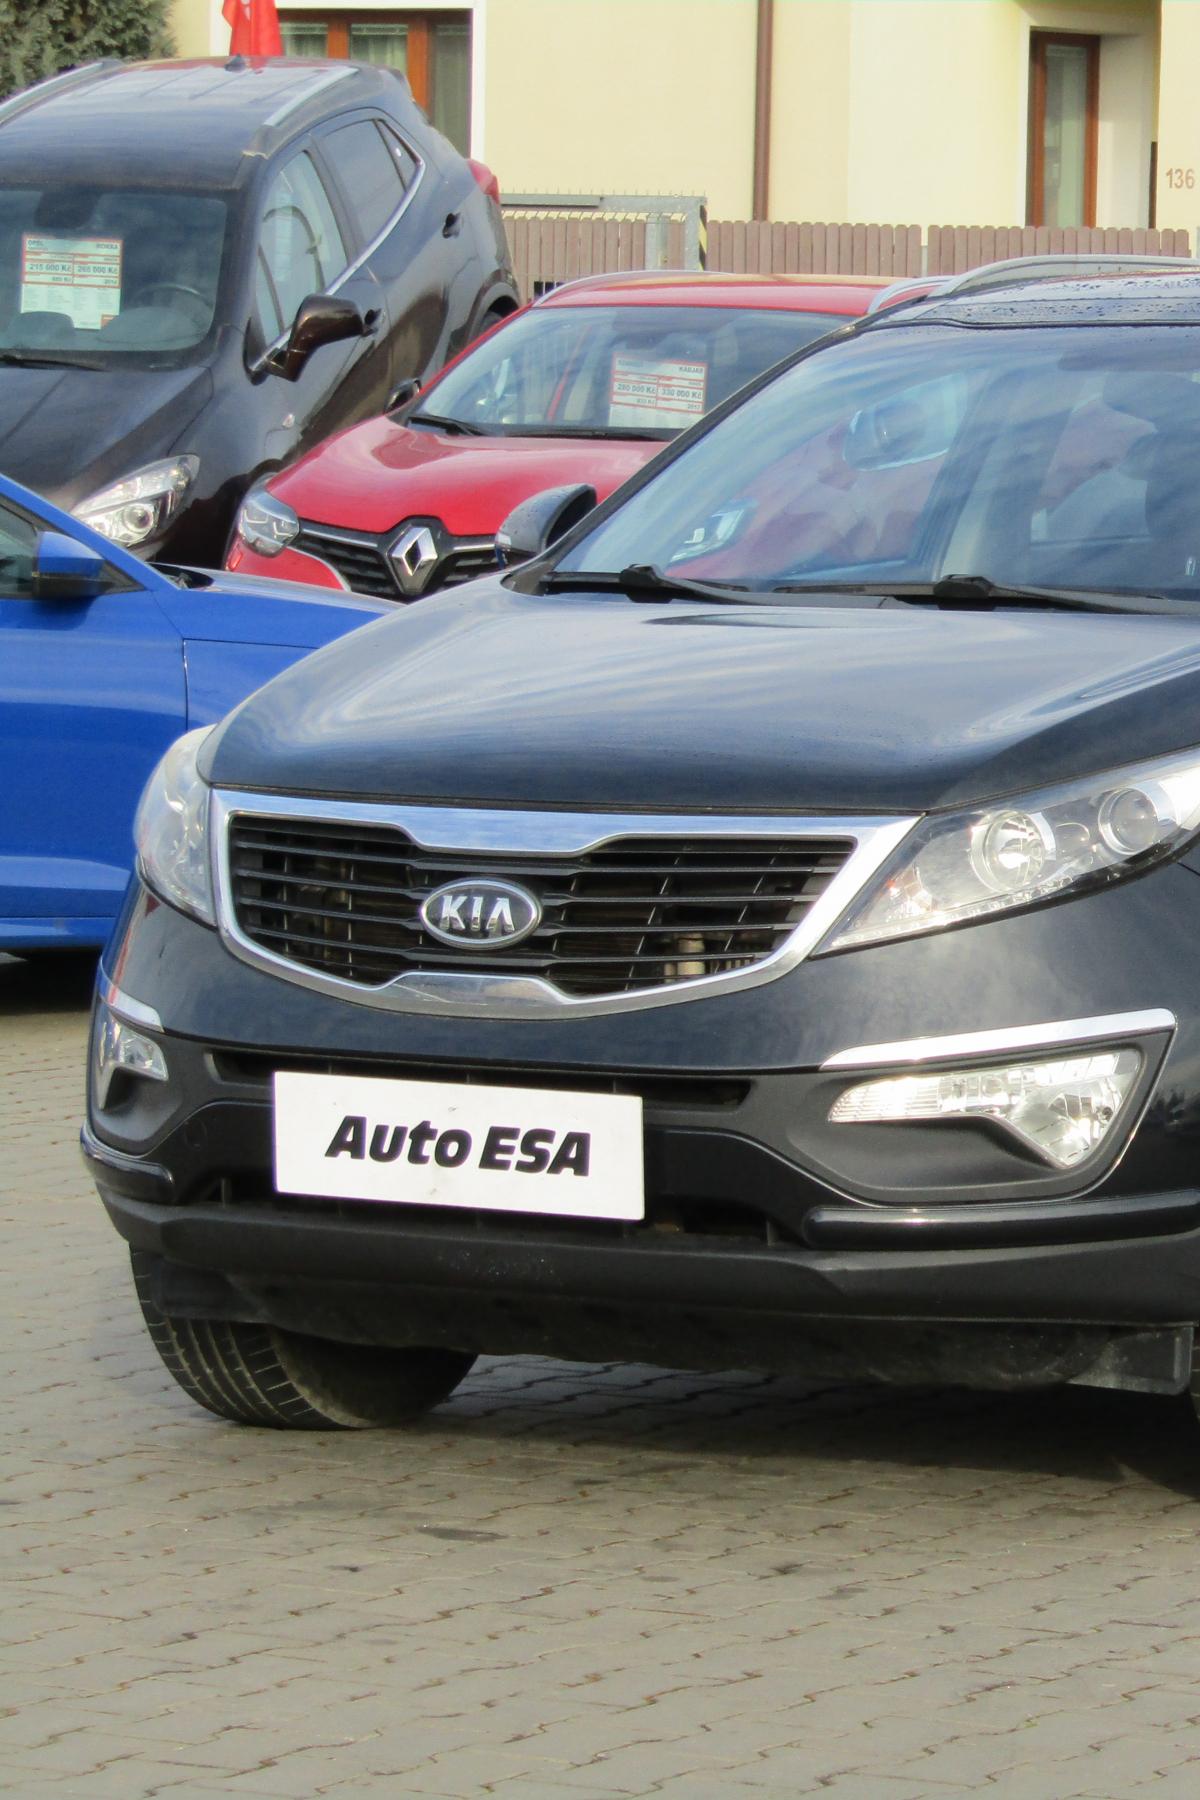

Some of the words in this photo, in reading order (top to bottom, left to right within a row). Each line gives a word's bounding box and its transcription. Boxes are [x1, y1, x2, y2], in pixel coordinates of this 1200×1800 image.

[1165, 167, 1195, 190] 136
[438, 894, 516, 932] KIA
[325, 1115, 473, 1168] Auto
[478, 1126, 591, 1177] ESA
